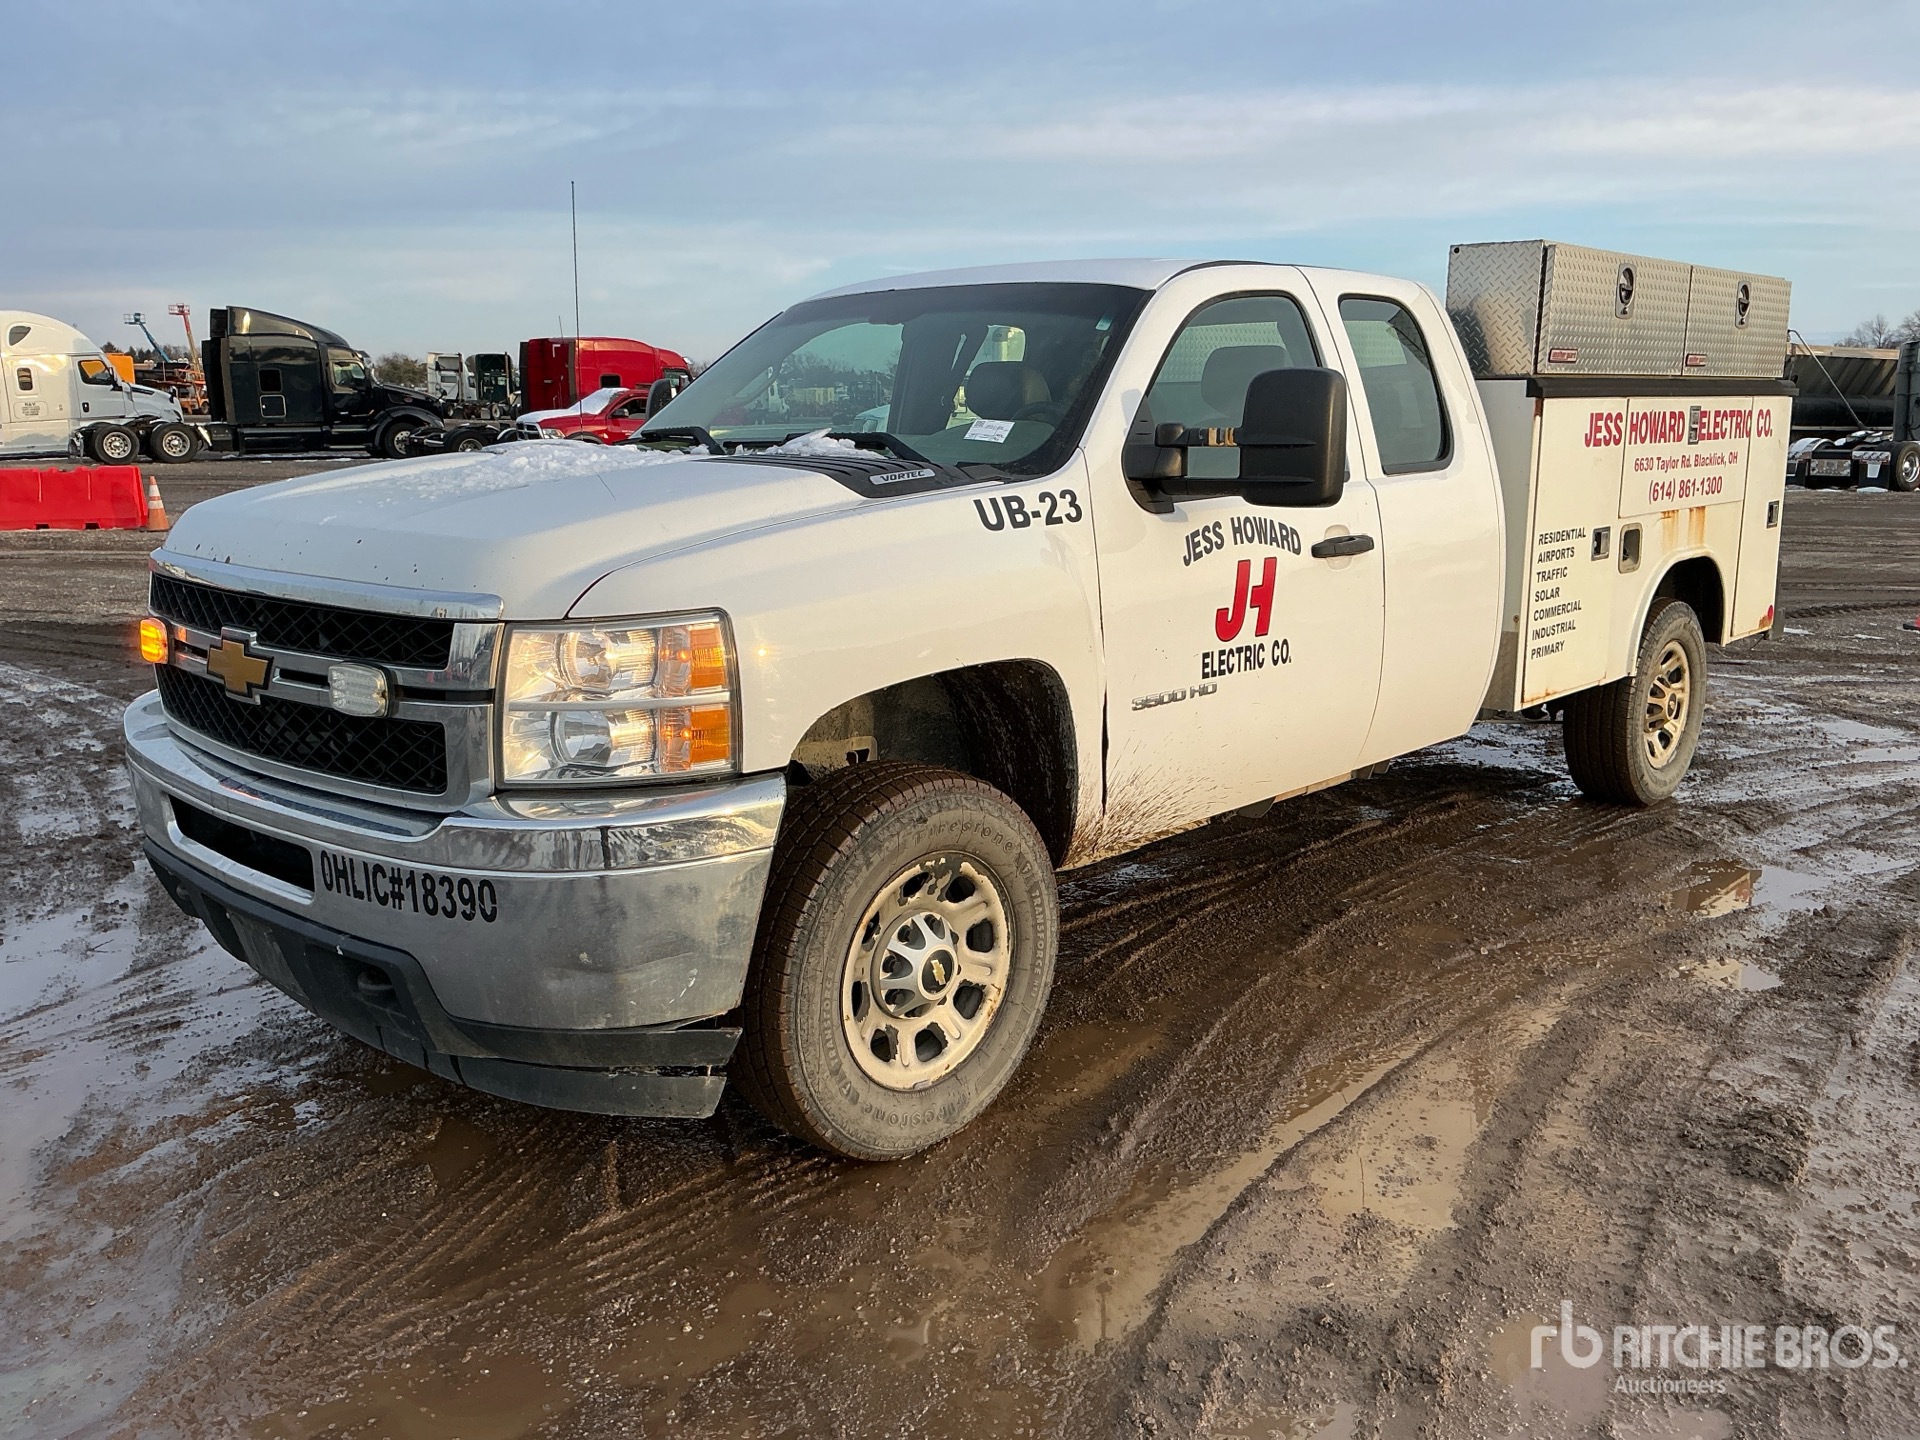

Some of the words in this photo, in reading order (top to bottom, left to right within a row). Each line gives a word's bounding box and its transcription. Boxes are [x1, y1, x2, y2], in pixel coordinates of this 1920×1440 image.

[1584, 412, 1623, 447] JESS
[1628, 409, 1685, 445] HOWARD
[1699, 409, 1752, 441] ELECTRIC
[1756, 409, 1772, 438] CO.
[1634, 457, 1654, 472] 6630
[1656, 456, 1679, 474] Taylor
[1681, 455, 1692, 468] Rd.
[1694, 453, 1726, 468] Blacklick,
[1728, 452, 1738, 464] OH
[880, 470, 925, 482] VORTEC
[1649, 478, 1675, 504] (614)
[1679, 476, 1722, 499] 861-1300
[974, 489, 1082, 531] UB-23
[1183, 521, 1224, 567] JESS
[1230, 516, 1301, 555] HOWARD
[1538, 527, 1586, 546] RESIDENTIAL
[1537, 547, 1575, 564] AIRPORTS
[1536, 567, 1568, 583] TRAFFIC
[1215, 557, 1277, 642] JH
[1535, 587, 1560, 603] SOLAR
[1533, 600, 1582, 621] COMMERCIAL
[1532, 620, 1576, 640] INDUSTRIAL
[1202, 643, 1265, 679] ELECTRIC
[1271, 639, 1292, 666] CO.
[1531, 640, 1565, 660] PRIMARY
[1131, 687, 1186, 711] 3500
[1190, 682, 1217, 699] HD
[913, 820, 1014, 852] Firestone
[1031, 889, 1045, 975] TRANSFORCE
